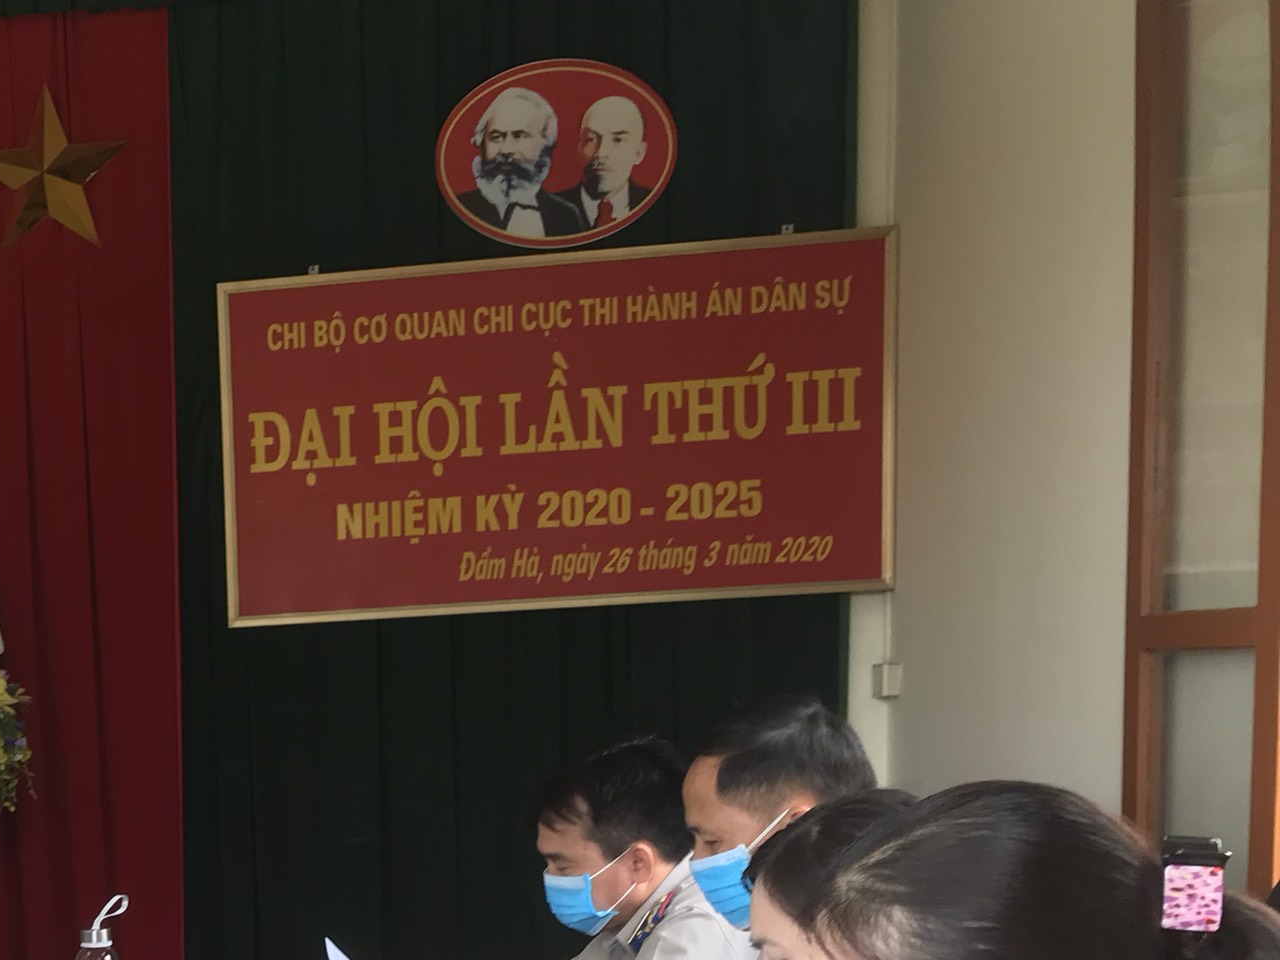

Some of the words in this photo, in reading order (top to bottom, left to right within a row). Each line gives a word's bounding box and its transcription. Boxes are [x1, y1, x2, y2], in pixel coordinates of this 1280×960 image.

[267, 321, 306, 351] CHI
[313, 312, 346, 354] BỘ
[353, 314, 389, 345] CƠ
[394, 309, 466, 342] QUAN
[472, 305, 513, 335] CHI
[520, 300, 572, 337] CỤC
[579, 297, 618, 325] THI
[626, 283, 697, 321] HÀNH
[704, 281, 743, 316] ÁN
[750, 275, 807, 314] DÂN
[815, 274, 853, 315] SỰ
[248, 404, 357, 486] ĐẠI
[372, 375, 483, 477] HỘI
[497, 350, 628, 456] LẦN
[643, 352, 775, 445] THỨ
[786, 367, 861, 435] III
[336, 489, 462, 544] NHIỆM
[475, 483, 525, 532] KỲ
[536, 487, 632, 529] 2020
[639, 506, 654, 516] -
[665, 480, 762, 521] 2025
[511, 545, 544, 585] Hà,
[550, 546, 600, 582] ngày
[602, 547, 634, 574] 26
[637, 539, 698, 576] tháng
[703, 541, 722, 567] 3
[725, 535, 772, 566] năm
[775, 535, 834, 564] 2020
